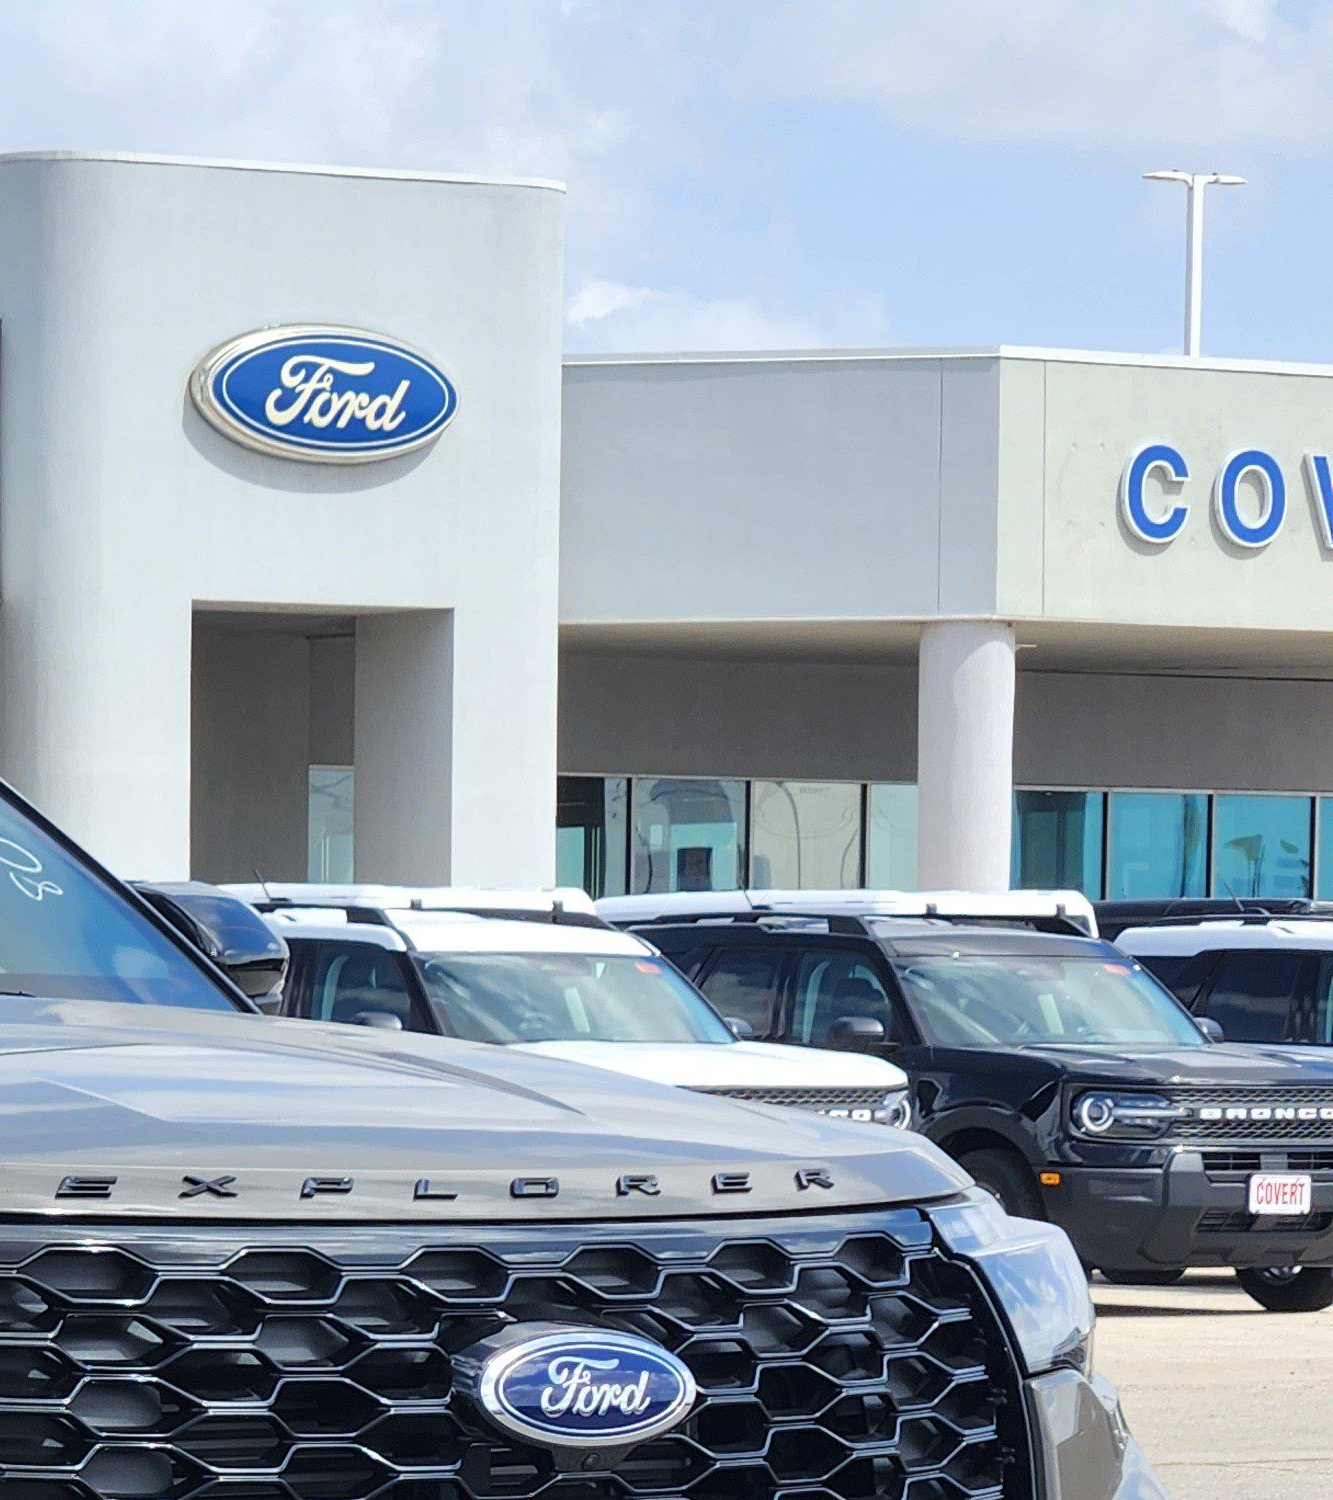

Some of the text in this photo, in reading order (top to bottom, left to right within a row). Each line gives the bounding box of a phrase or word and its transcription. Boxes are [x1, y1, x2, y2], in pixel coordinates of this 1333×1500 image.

[264, 354, 411, 431] Ford
[53, 1167, 836, 1201] EXPLORER
[1256, 1181, 1305, 1205] COVERT
[540, 1355, 651, 1419] Ford
